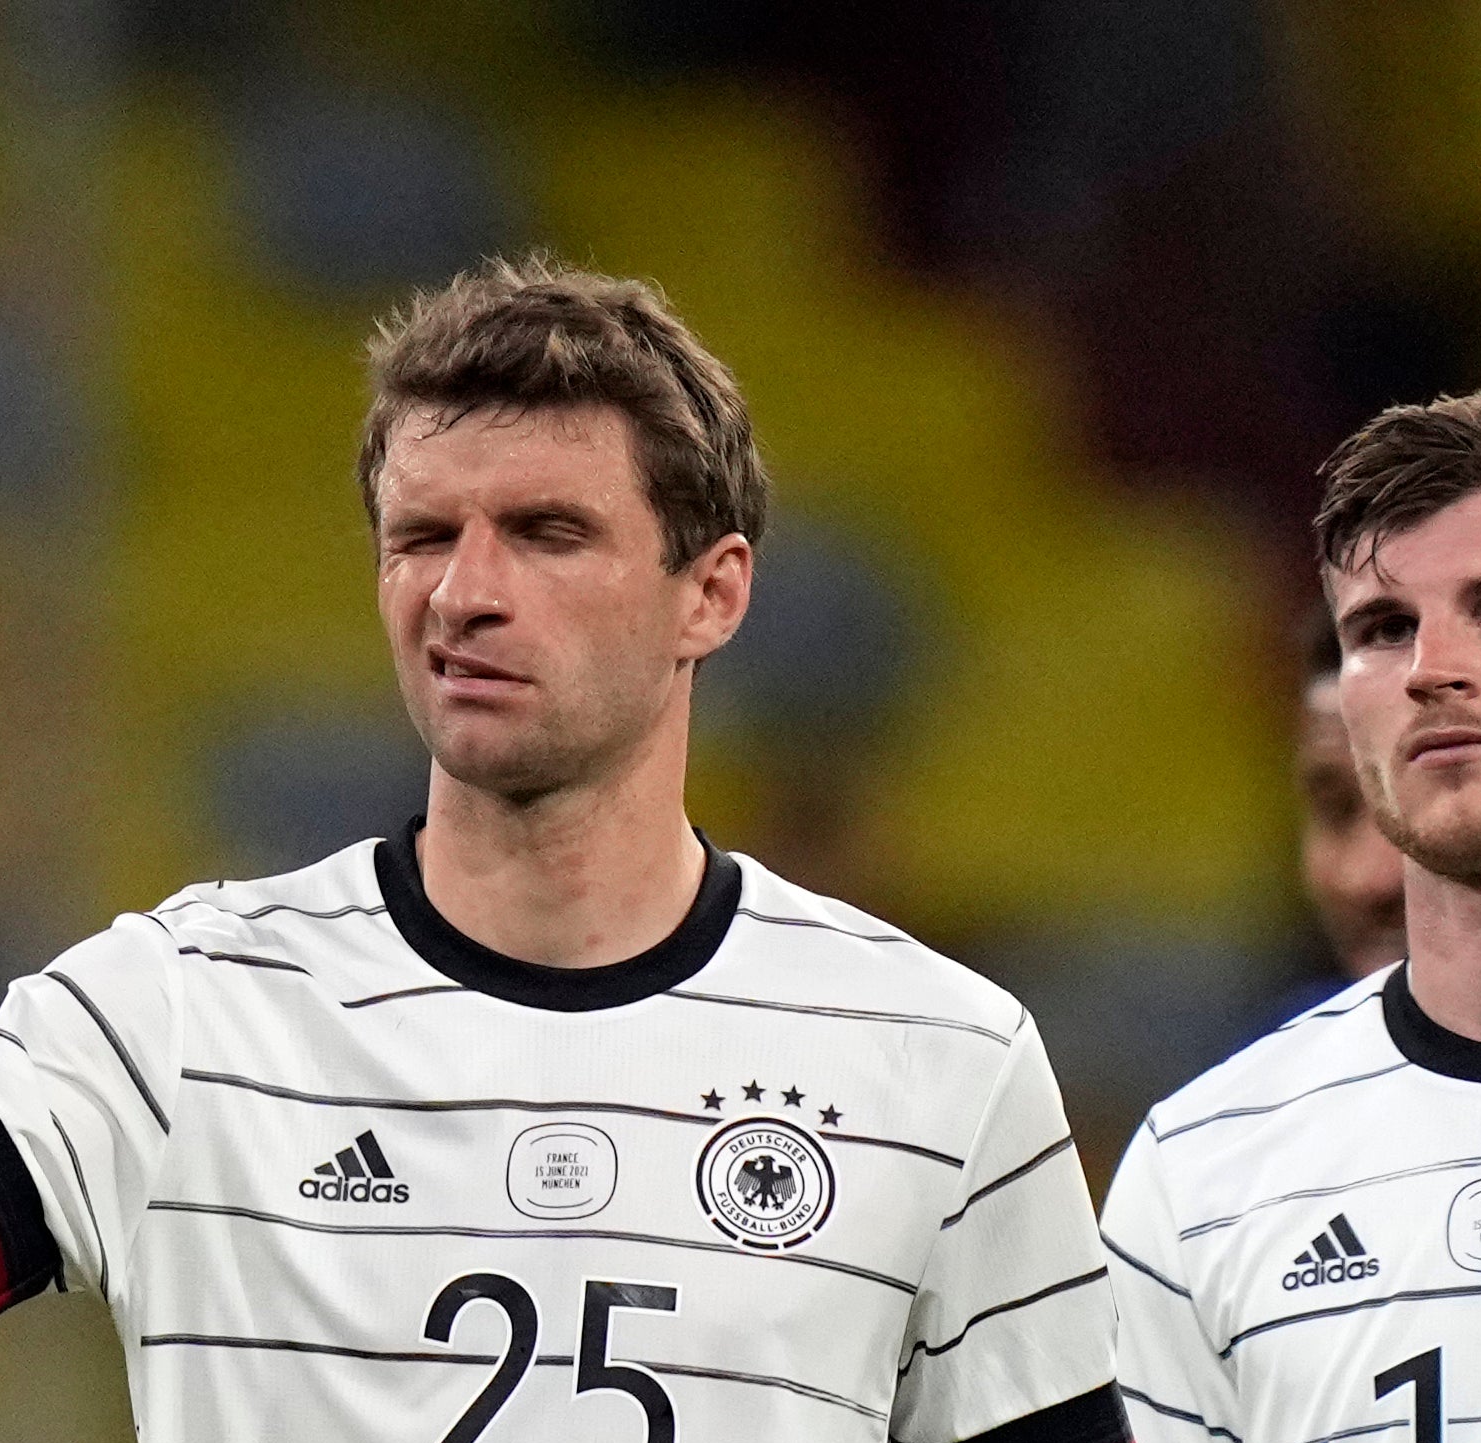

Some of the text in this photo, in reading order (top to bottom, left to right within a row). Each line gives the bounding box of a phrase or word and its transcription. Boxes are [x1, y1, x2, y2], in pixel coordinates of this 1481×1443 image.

[546, 1152, 580, 1164] FRANCE
[728, 1134, 807, 1164] DEUTSCHER
[535, 1165, 589, 1178] 15 JUNE 2021
[298, 1174, 410, 1205] adidas
[717, 1191, 812, 1232] FUSSBALL-BUND
[1281, 1252, 1380, 1293] adidas
